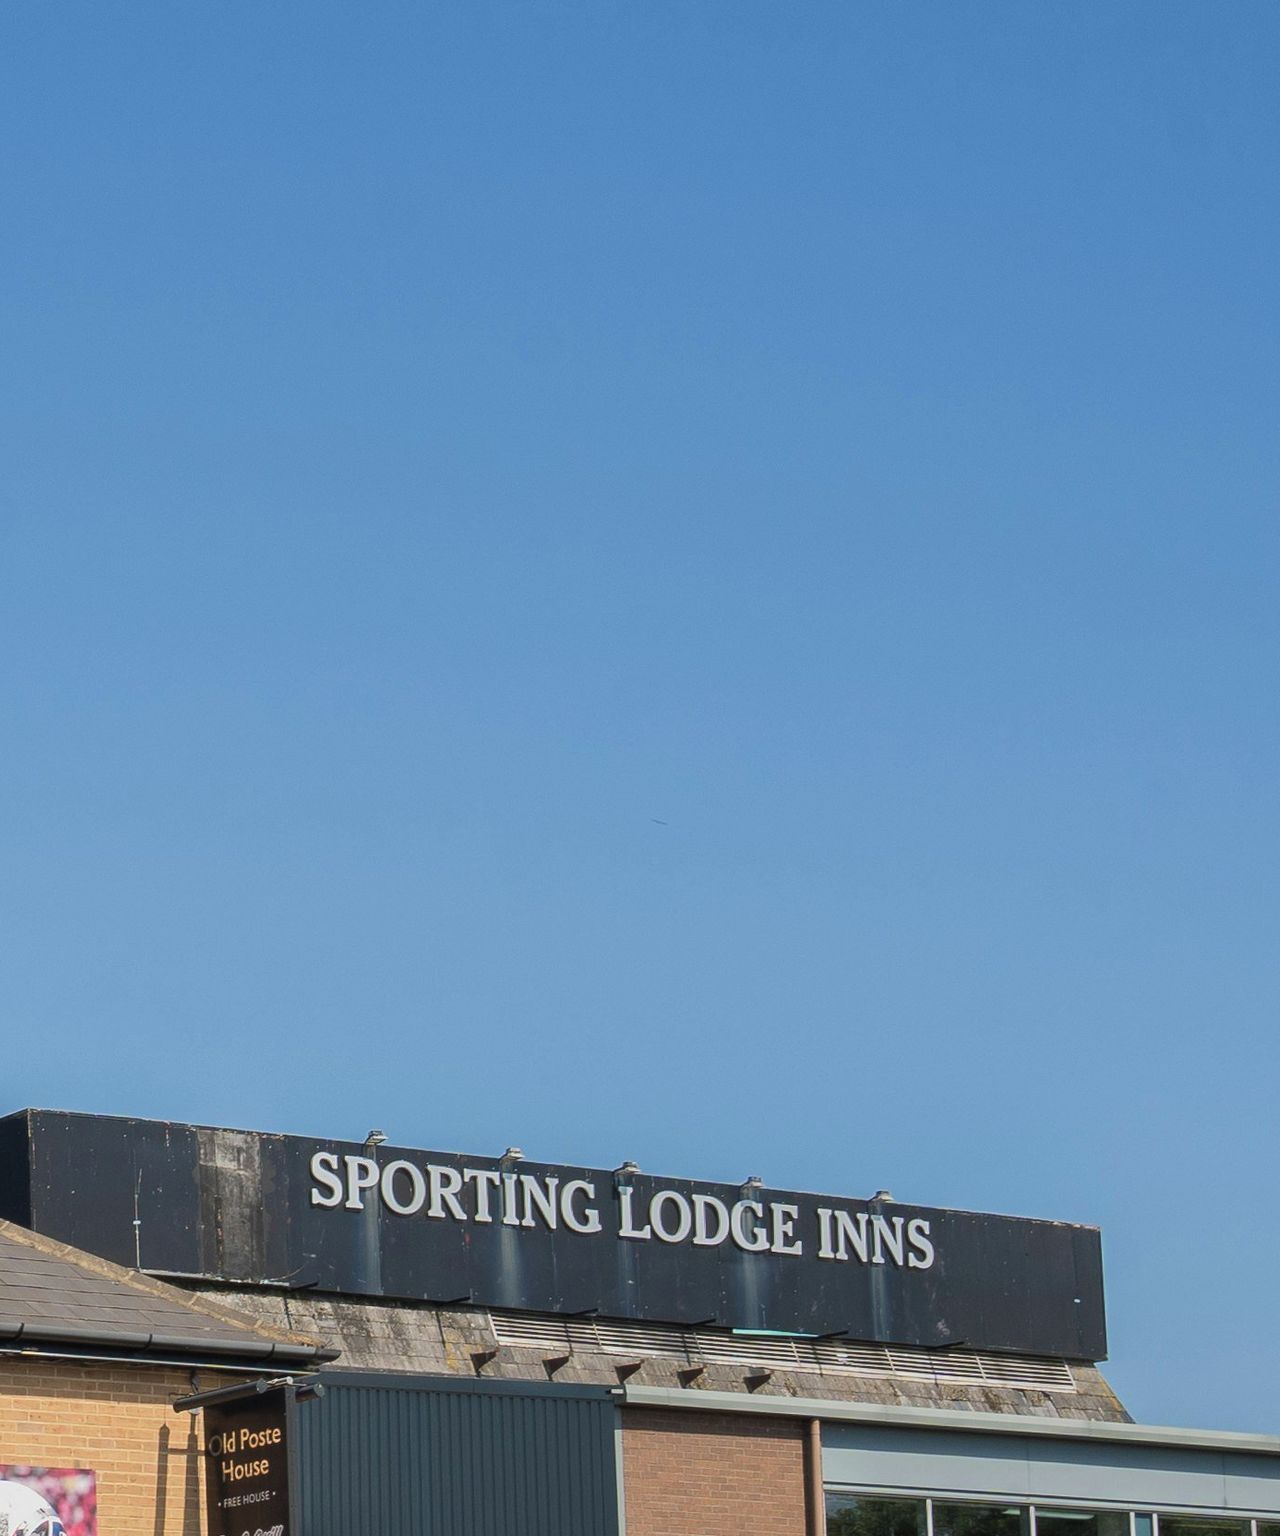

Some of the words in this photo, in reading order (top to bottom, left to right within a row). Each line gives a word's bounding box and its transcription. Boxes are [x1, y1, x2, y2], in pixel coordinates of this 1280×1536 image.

[310, 1151, 603, 1234] SPORTING
[618, 1185, 804, 1257] LODGE
[816, 1207, 936, 1270] INNS
[208, 1430, 236, 1457] Old
[240, 1427, 282, 1451] Poste
[222, 1459, 270, 1483] House
[223, 1495, 242, 1509] FREE
[243, 1490, 271, 1505] HOUSE
